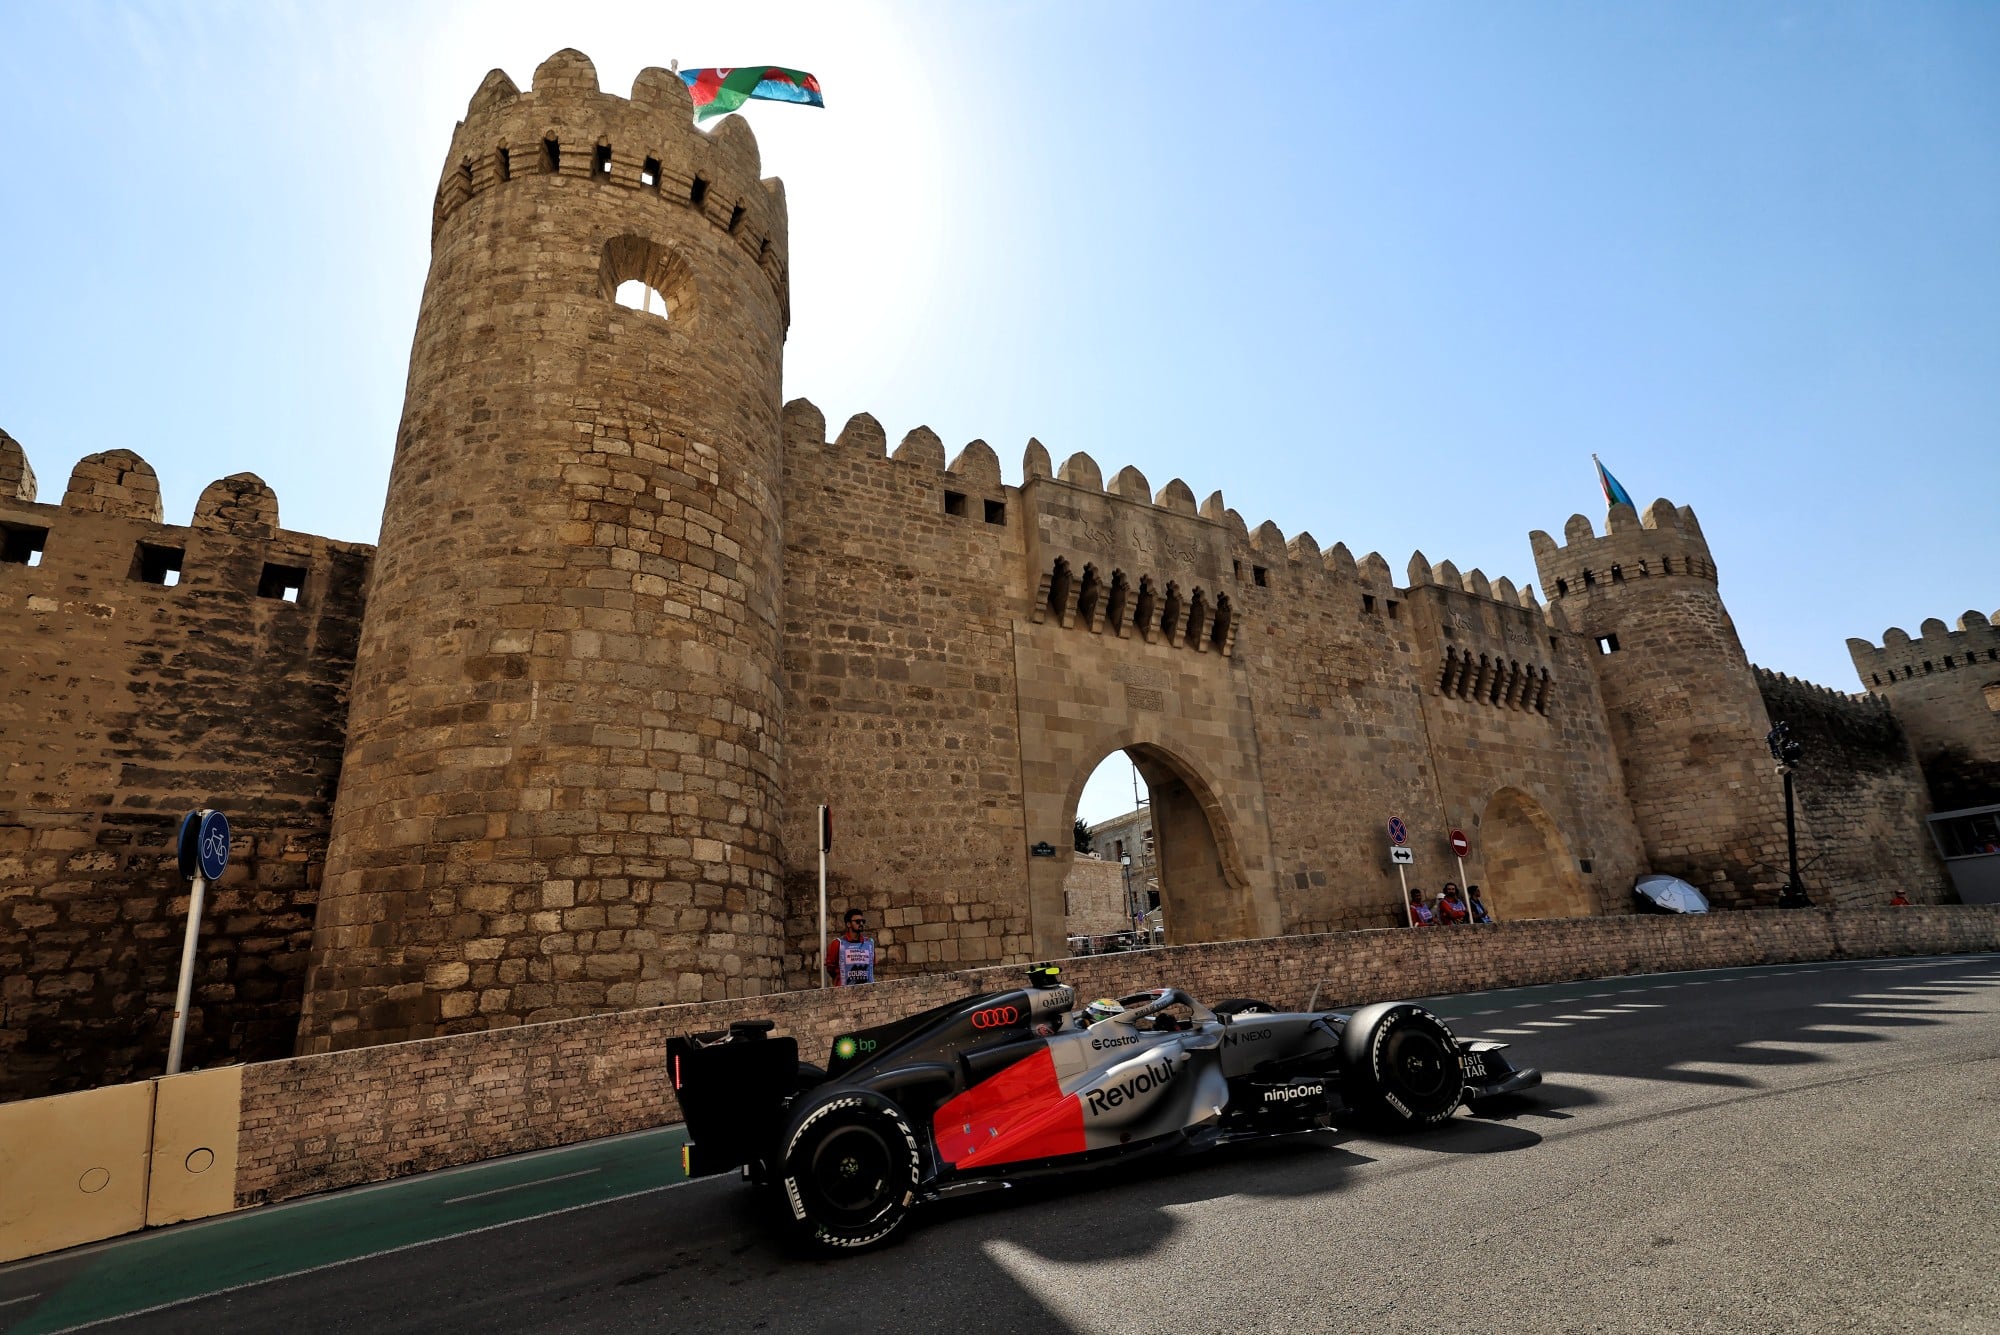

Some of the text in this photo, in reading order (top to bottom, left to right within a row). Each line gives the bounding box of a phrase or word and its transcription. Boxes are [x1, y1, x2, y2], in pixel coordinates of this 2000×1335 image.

[1049, 990, 1069, 998] VISIT
[1043, 996, 1071, 1008] QATAR
[1412, 1008, 1422, 1016] P
[1102, 1034, 1139, 1049] Castrol
[1241, 1029, 1272, 1042] NEXO
[859, 1038, 877, 1053] bp
[1463, 1053, 1483, 1066] isit
[1463, 1064, 1487, 1079] TAR
[1085, 1056, 1177, 1116] Revolut
[1264, 1085, 1323, 1102] ninjaOne
[883, 1107, 920, 1185] P ZERO
[784, 1176, 807, 1221] PIRELLI
